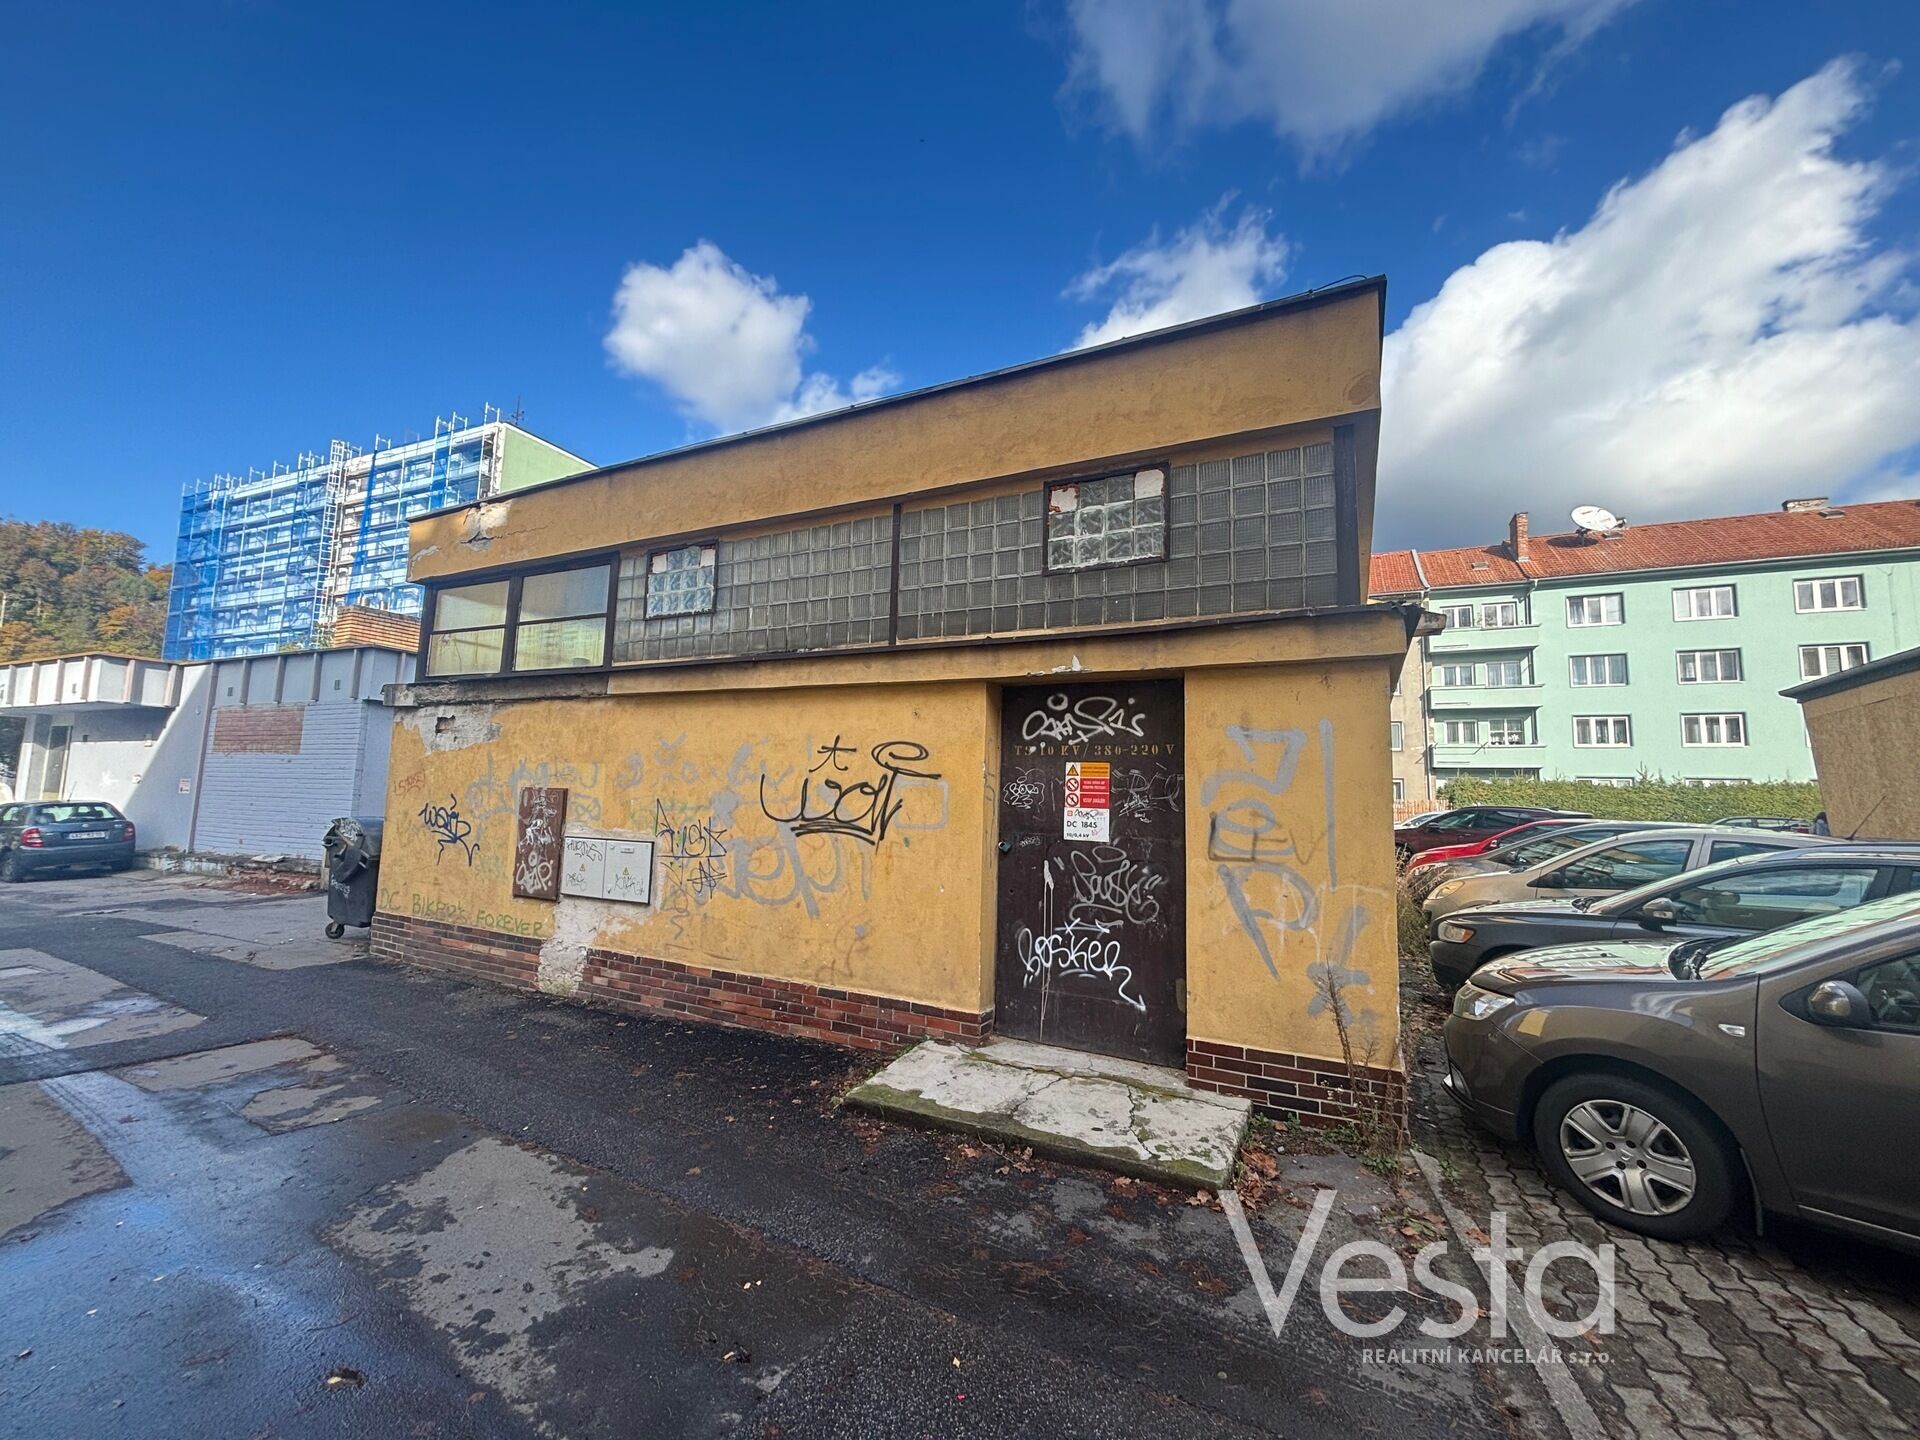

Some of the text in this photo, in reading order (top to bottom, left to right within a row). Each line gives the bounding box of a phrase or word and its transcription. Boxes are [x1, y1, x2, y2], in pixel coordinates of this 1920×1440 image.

[1165, 743, 1175, 755] V
[1066, 820, 1098, 829] DC 1845
